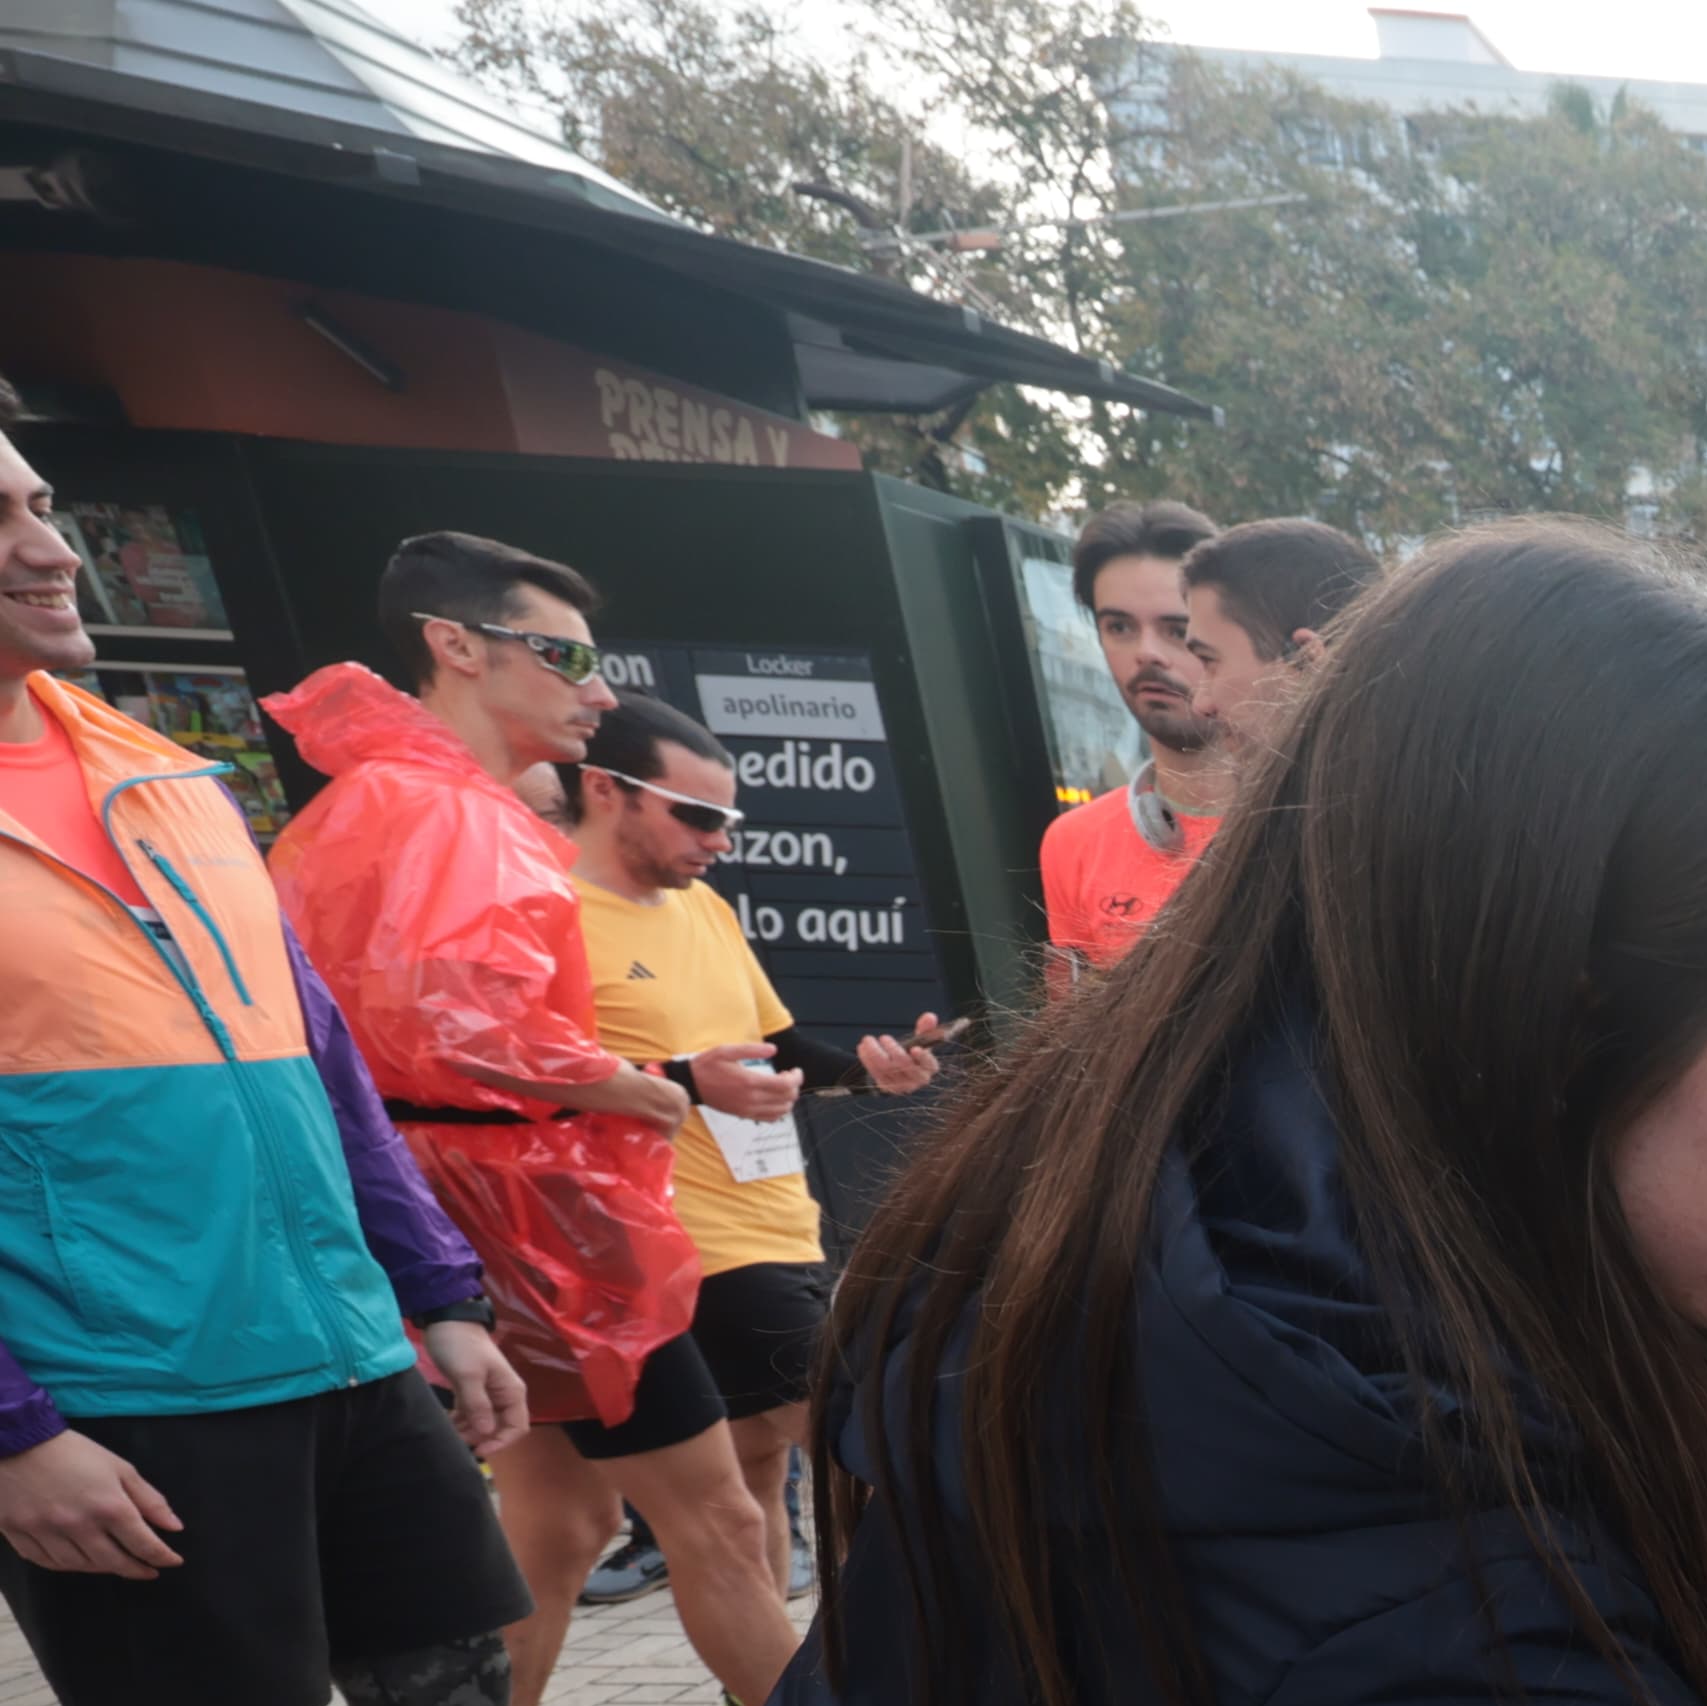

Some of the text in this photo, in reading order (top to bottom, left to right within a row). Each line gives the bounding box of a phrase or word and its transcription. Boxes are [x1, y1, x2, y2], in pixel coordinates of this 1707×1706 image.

[595, 367, 759, 467] PRENSA
[602, 653, 654, 686] on
[745, 653, 814, 677] Locker
[724, 694, 857, 720] apolinario
[735, 741, 876, 792] edido
[717, 831, 847, 876] azon,
[738, 894, 907, 951] lo aquí
